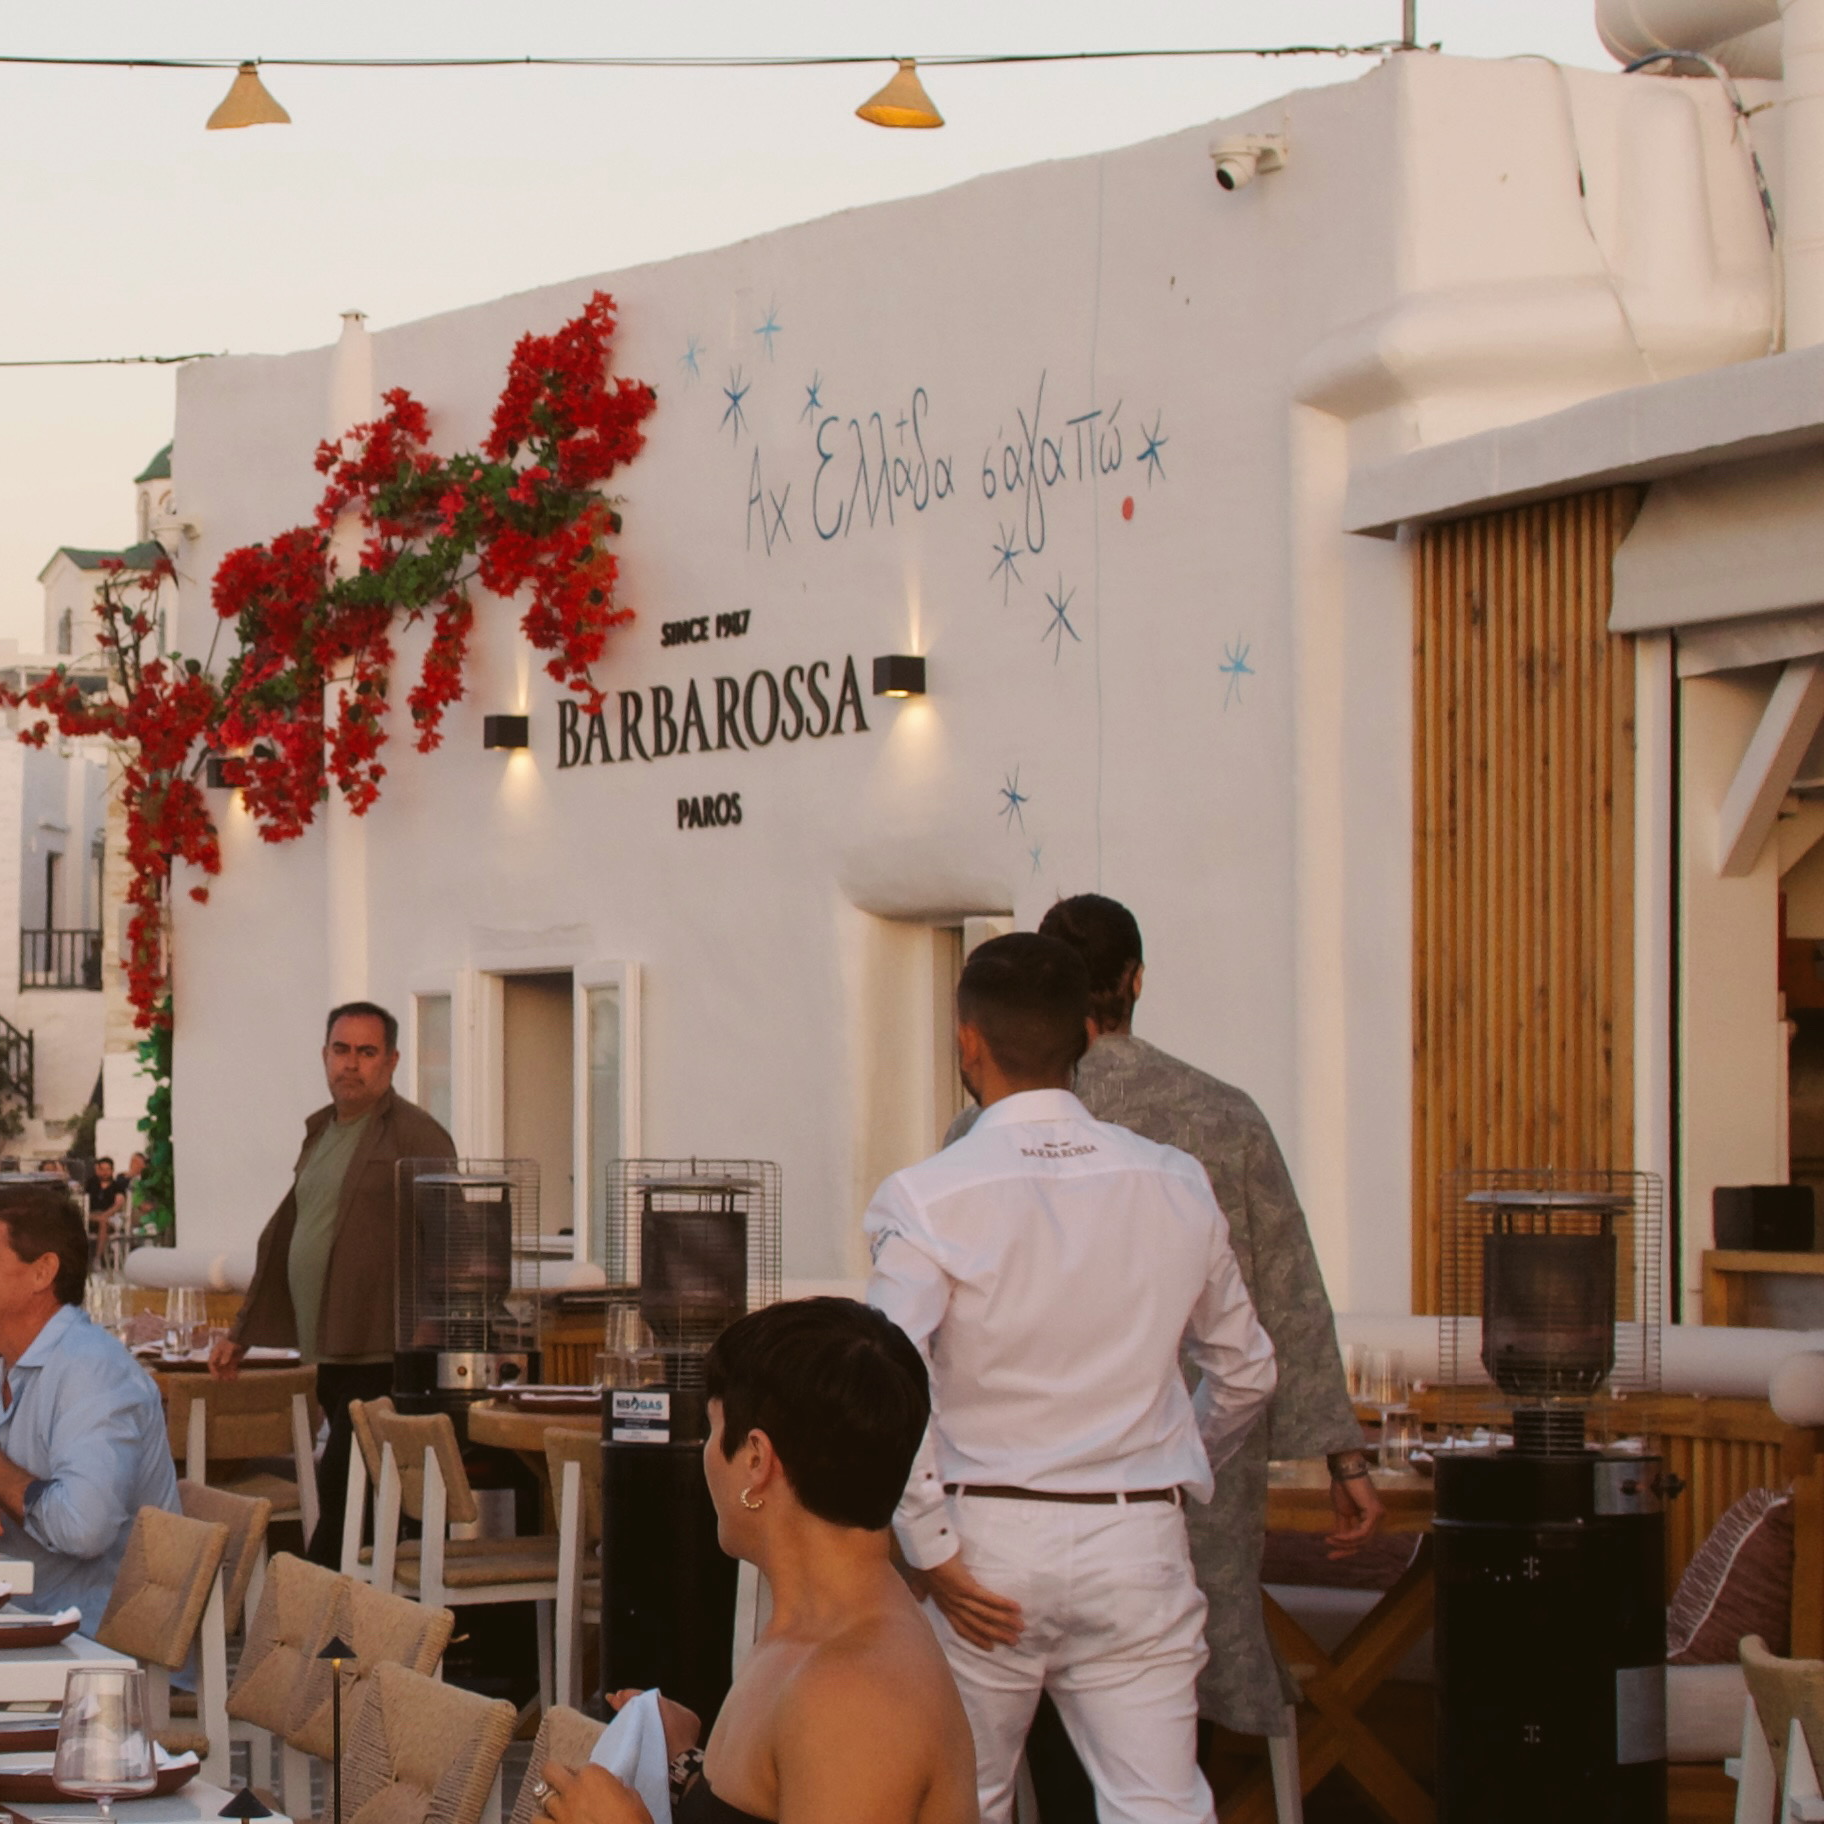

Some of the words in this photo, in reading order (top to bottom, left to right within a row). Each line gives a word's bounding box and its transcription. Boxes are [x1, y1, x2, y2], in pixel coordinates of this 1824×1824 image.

[660, 616, 709, 647] SINCE
[556, 653, 871, 769] BARBAROSSA
[677, 792, 743, 830] PAROS
[1020, 1144, 1098, 1159] BARBAROSSA
